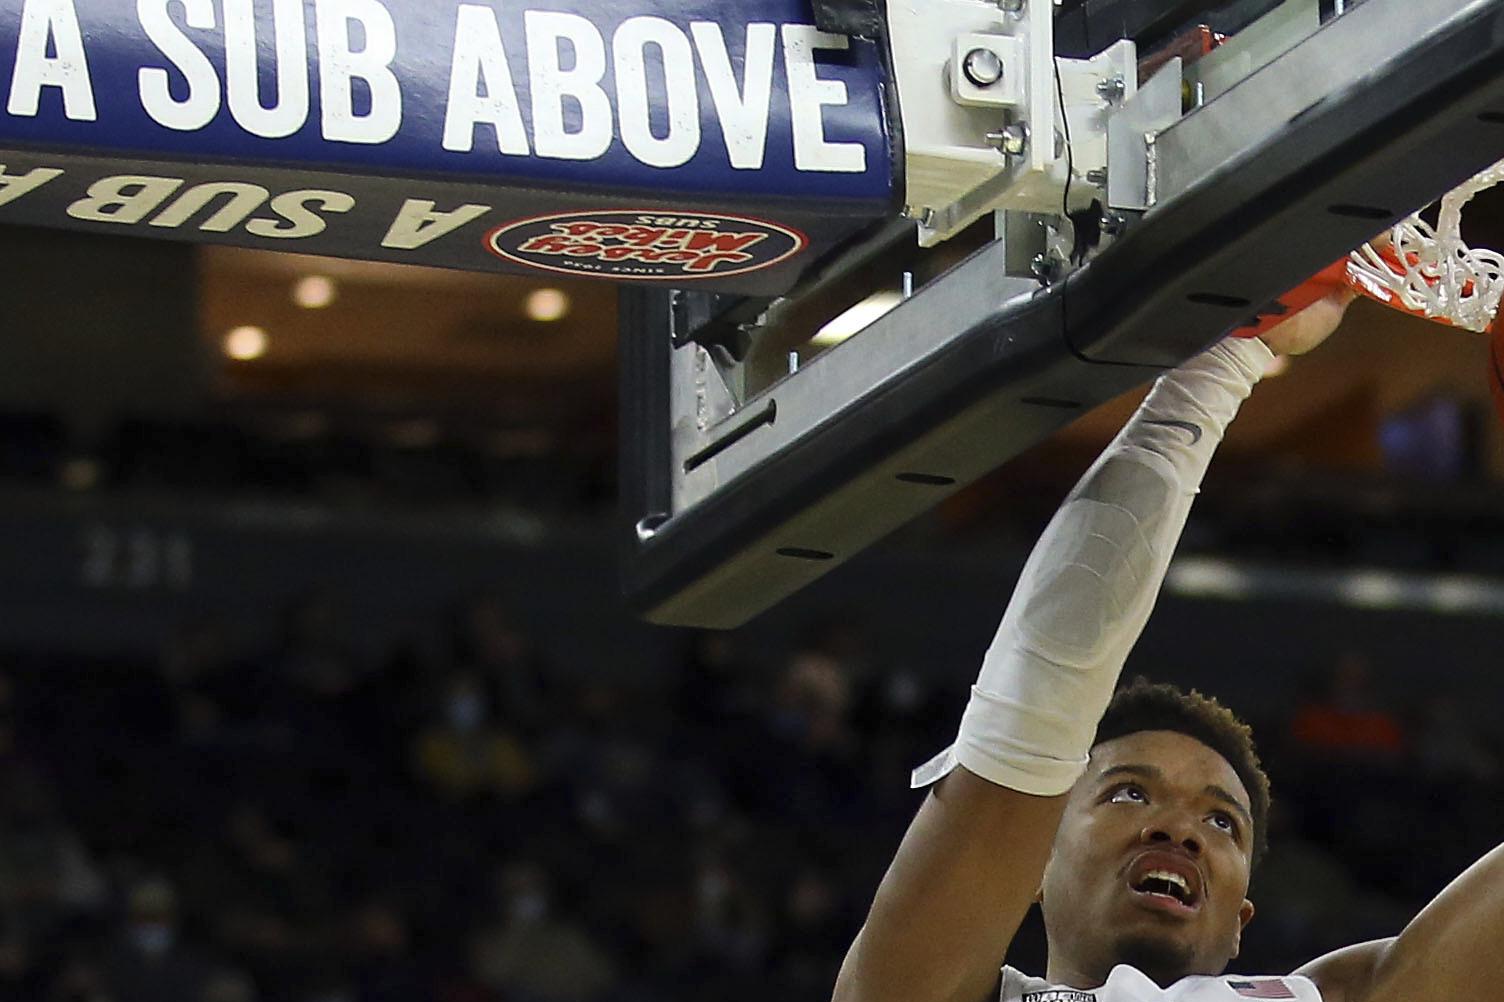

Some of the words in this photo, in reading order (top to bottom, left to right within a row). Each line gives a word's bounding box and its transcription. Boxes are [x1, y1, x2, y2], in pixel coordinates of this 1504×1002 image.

[8, 0, 97, 121] A
[136, 0, 402, 144] SUB
[442, 3, 867, 172] ABOVE
[66, 174, 355, 239] SUB
[380, 199, 491, 250] A
[634, 215, 720, 229] SUBS
[518, 234, 753, 272] Jersey
